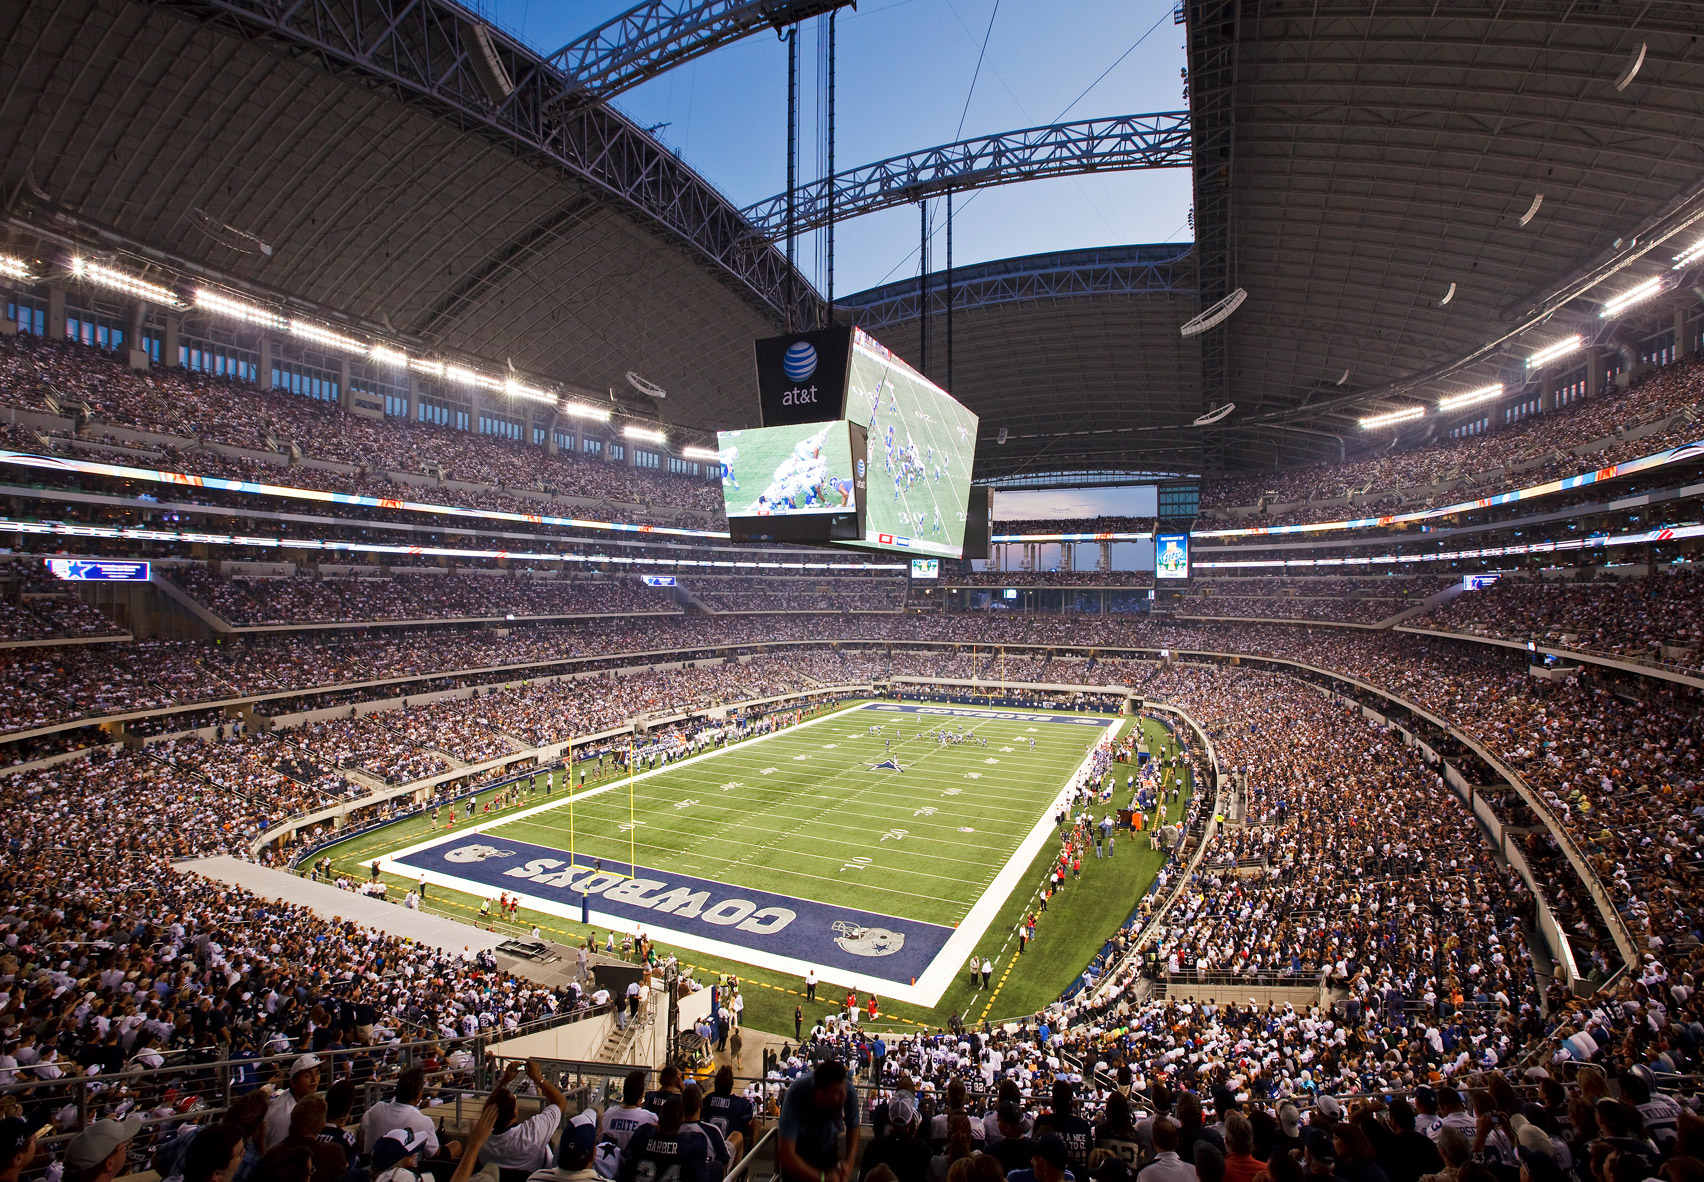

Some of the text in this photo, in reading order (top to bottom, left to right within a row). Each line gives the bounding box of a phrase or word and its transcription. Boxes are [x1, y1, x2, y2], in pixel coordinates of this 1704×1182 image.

[782, 385, 818, 406] at&t
[916, 708, 1053, 722] COWBOYS
[883, 828, 910, 841] 20
[844, 856, 874, 870] 10
[503, 858, 797, 935] COWBOYS
[710, 1096, 731, 1109] ROMO
[610, 1118, 639, 1132] WHITE
[1072, 1133, 1087, 1143] NICE
[646, 1138, 678, 1155] BARBER
